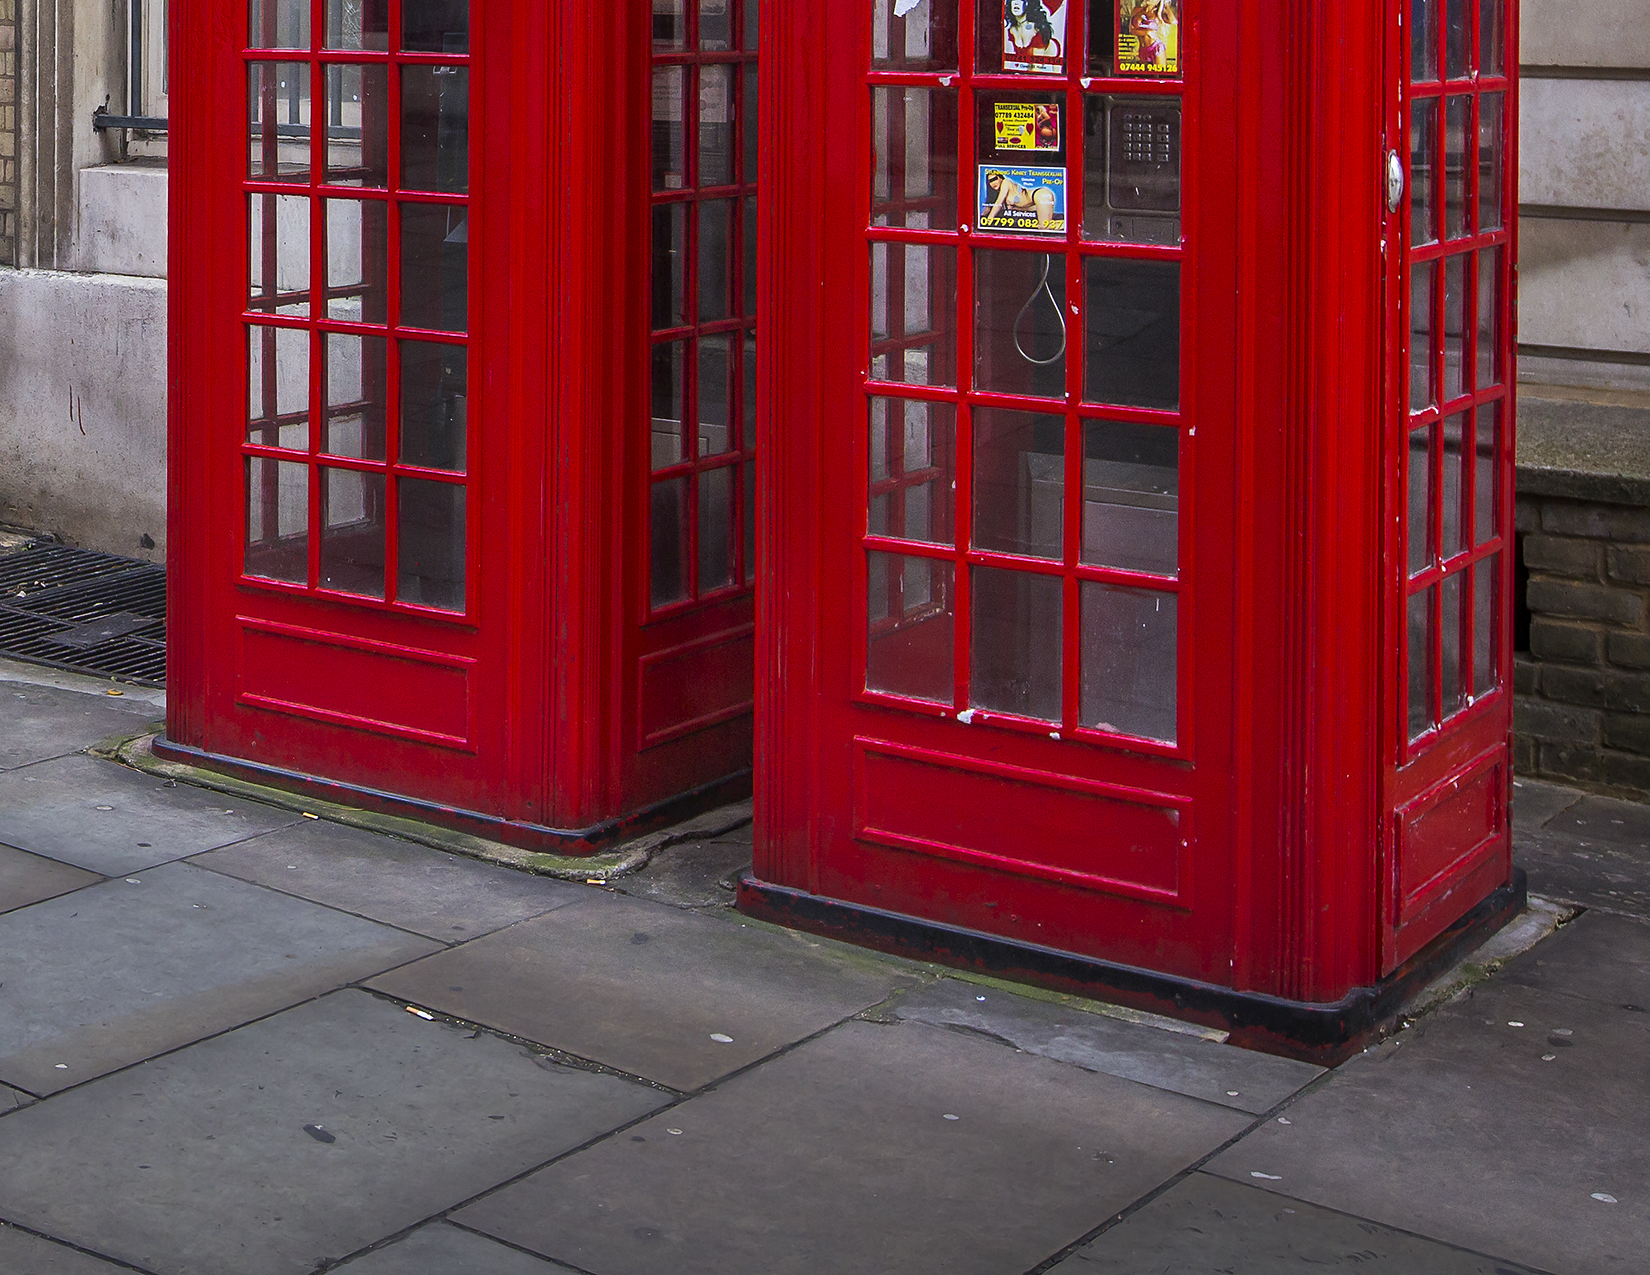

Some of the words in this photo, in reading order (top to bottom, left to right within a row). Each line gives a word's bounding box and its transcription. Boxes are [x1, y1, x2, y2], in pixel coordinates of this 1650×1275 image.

[1120, 63, 1145, 71] 07444
[1147, 63, 1178, 72] 945126
[980, 217, 1015, 227] 07799
[1017, 219, 1038, 228] 082
[1043, 220, 1064, 229] 937
